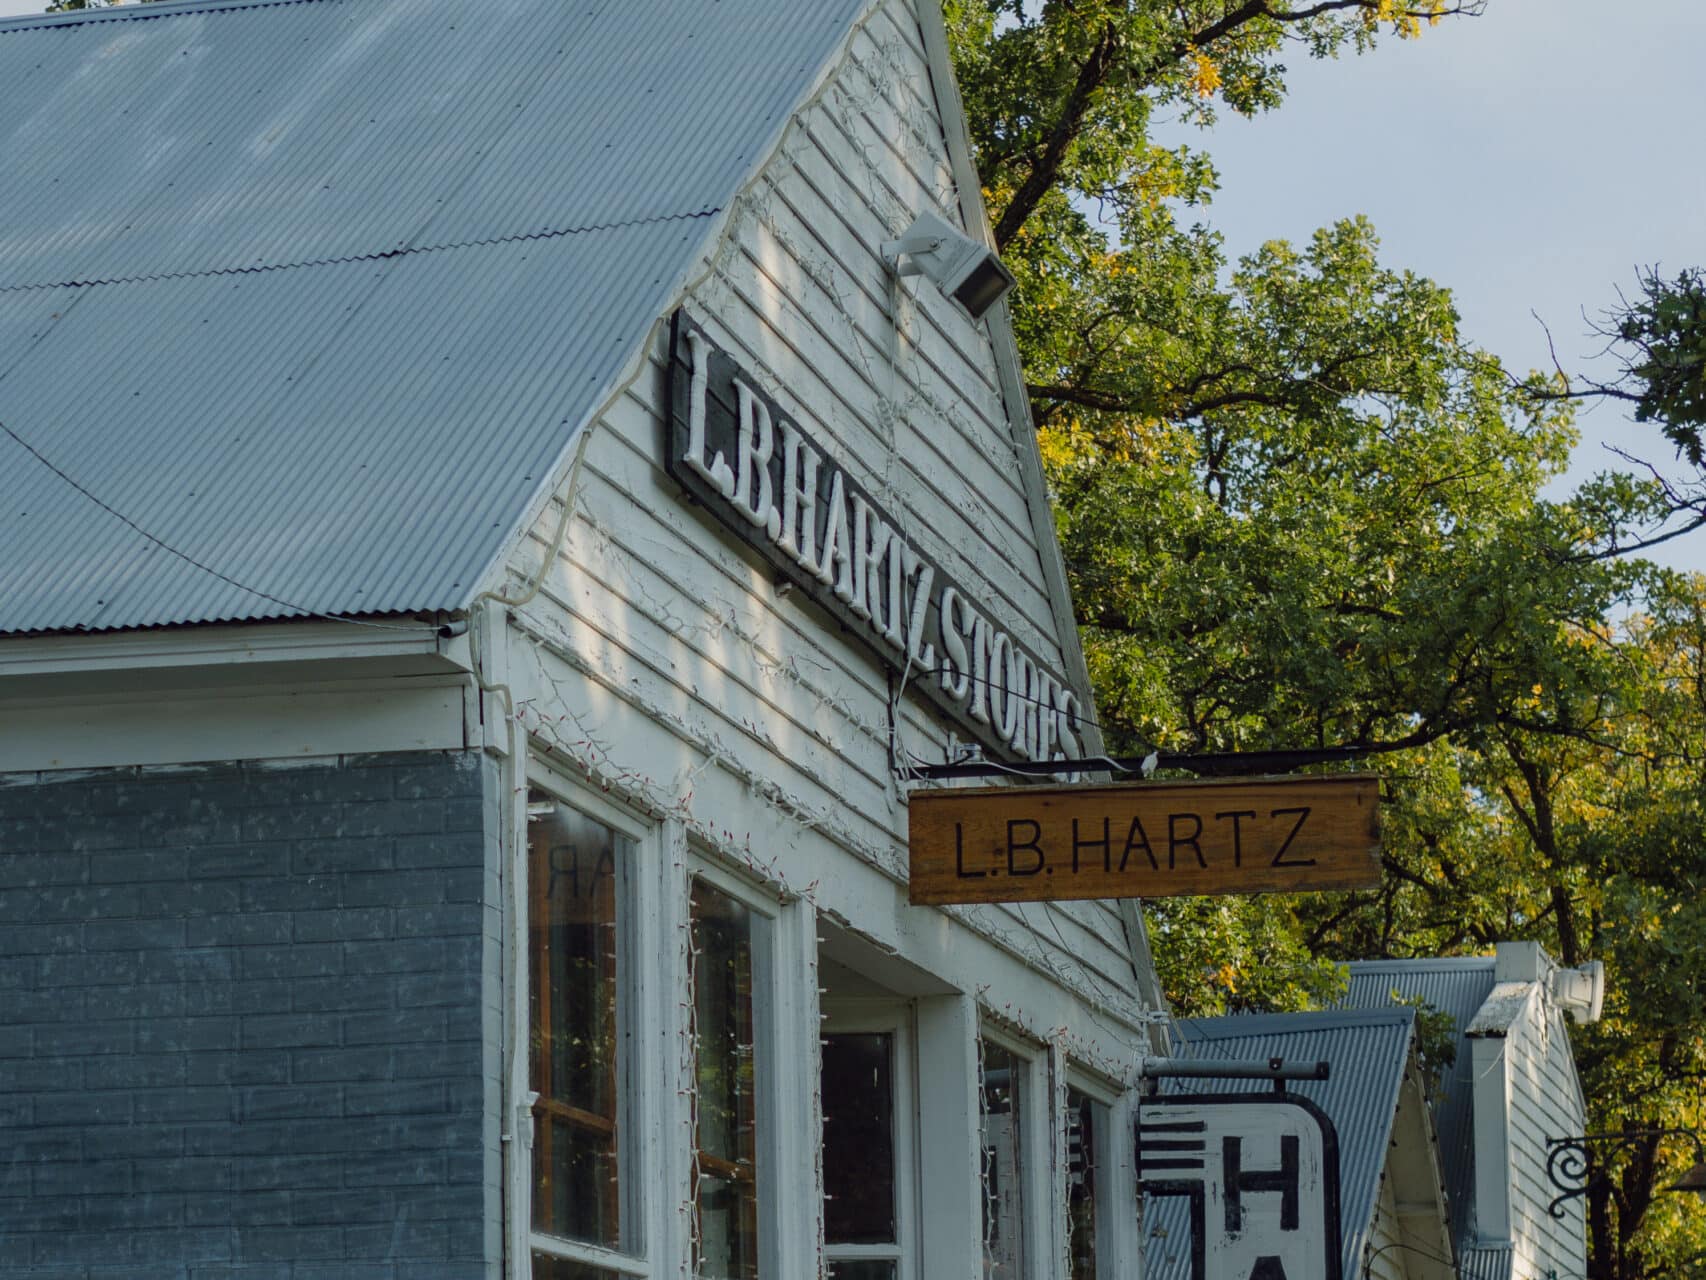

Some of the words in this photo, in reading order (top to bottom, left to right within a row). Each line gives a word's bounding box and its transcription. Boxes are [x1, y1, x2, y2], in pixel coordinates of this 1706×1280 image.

[777, 419, 935, 672] HARTZ
[940, 586, 1082, 782] STORES
[1072, 806, 1317, 874] HARTZ
